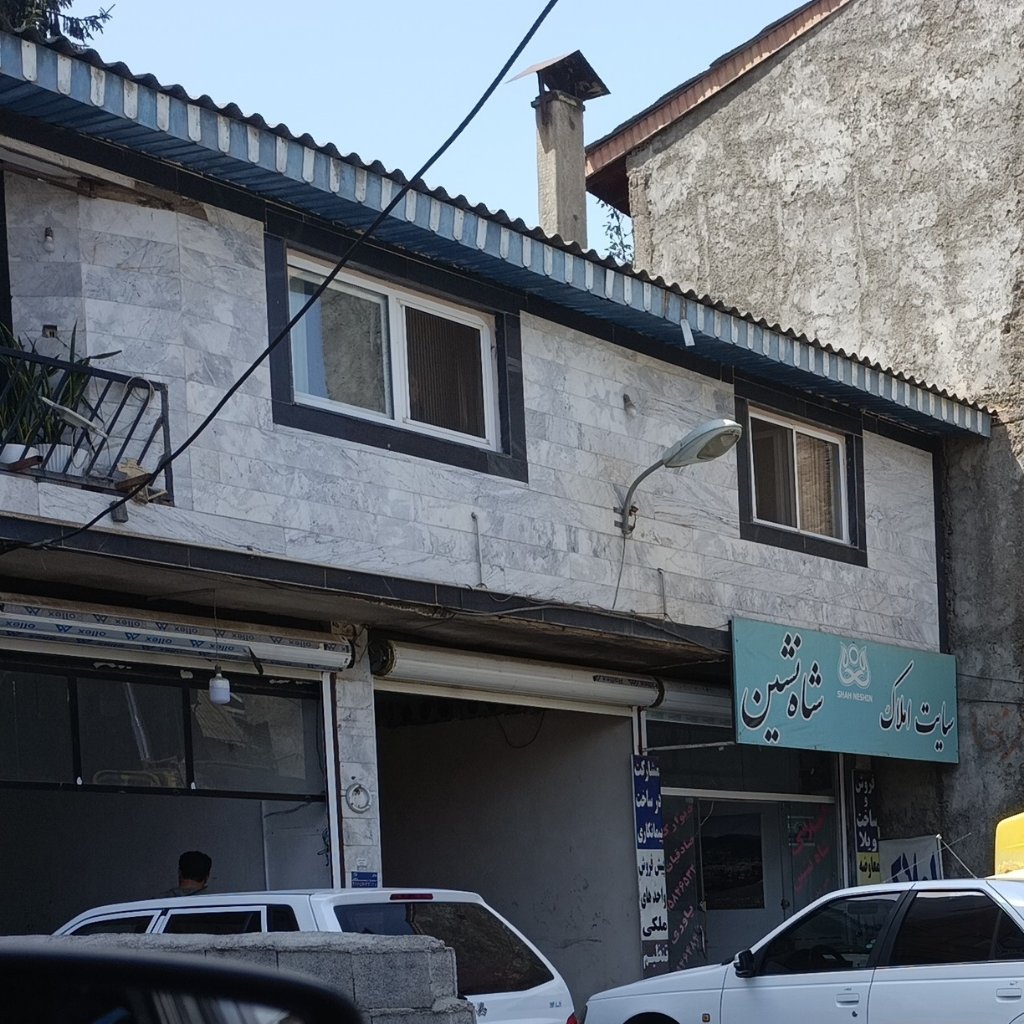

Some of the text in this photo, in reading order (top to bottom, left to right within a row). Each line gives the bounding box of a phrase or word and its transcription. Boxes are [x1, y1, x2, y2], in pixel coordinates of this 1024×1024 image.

[740, 631, 955, 753] سایت املاک شاه نشین
[855, 774, 876, 794] فروش
[636, 788, 654, 808] ساخت
[856, 808, 878, 827] ساخت
[858, 831, 878, 852] ویلا
[642, 916, 667, 937] ملکی
[643, 943, 669, 970] تنظیم
